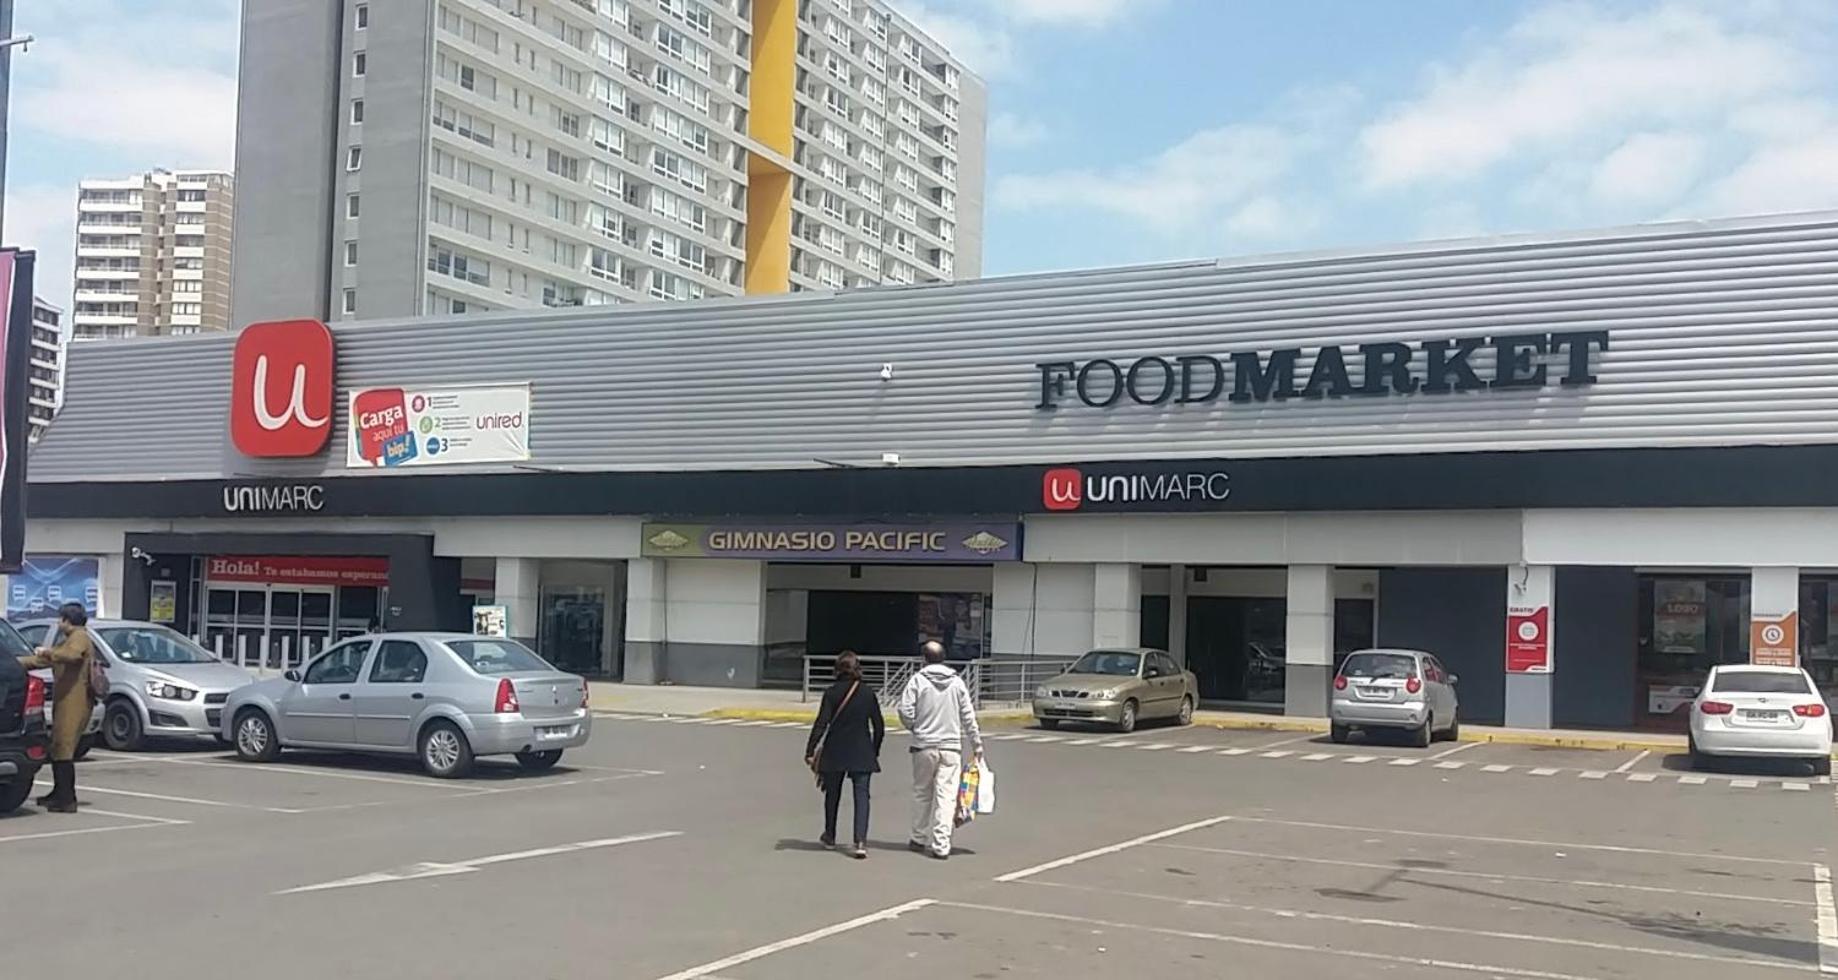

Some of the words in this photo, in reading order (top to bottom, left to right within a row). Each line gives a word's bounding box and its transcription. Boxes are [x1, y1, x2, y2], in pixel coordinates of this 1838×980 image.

[1035, 330, 1609, 409] FOODMARKET
[427, 396, 432, 408] 1
[360, 405, 403, 430] Carga
[434, 417, 442, 428] 2
[477, 411, 523, 430] unired
[386, 434, 411, 457] bip!
[441, 438, 449, 452] 3
[223, 484, 324, 511] UNIMARC
[1087, 472, 1230, 502] UNIMARC
[708, 530, 836, 551] GIMNASIO
[845, 530, 947, 551] PACIFIC
[211, 559, 260, 576] Hola!
[264, 566, 278, 577] Te
